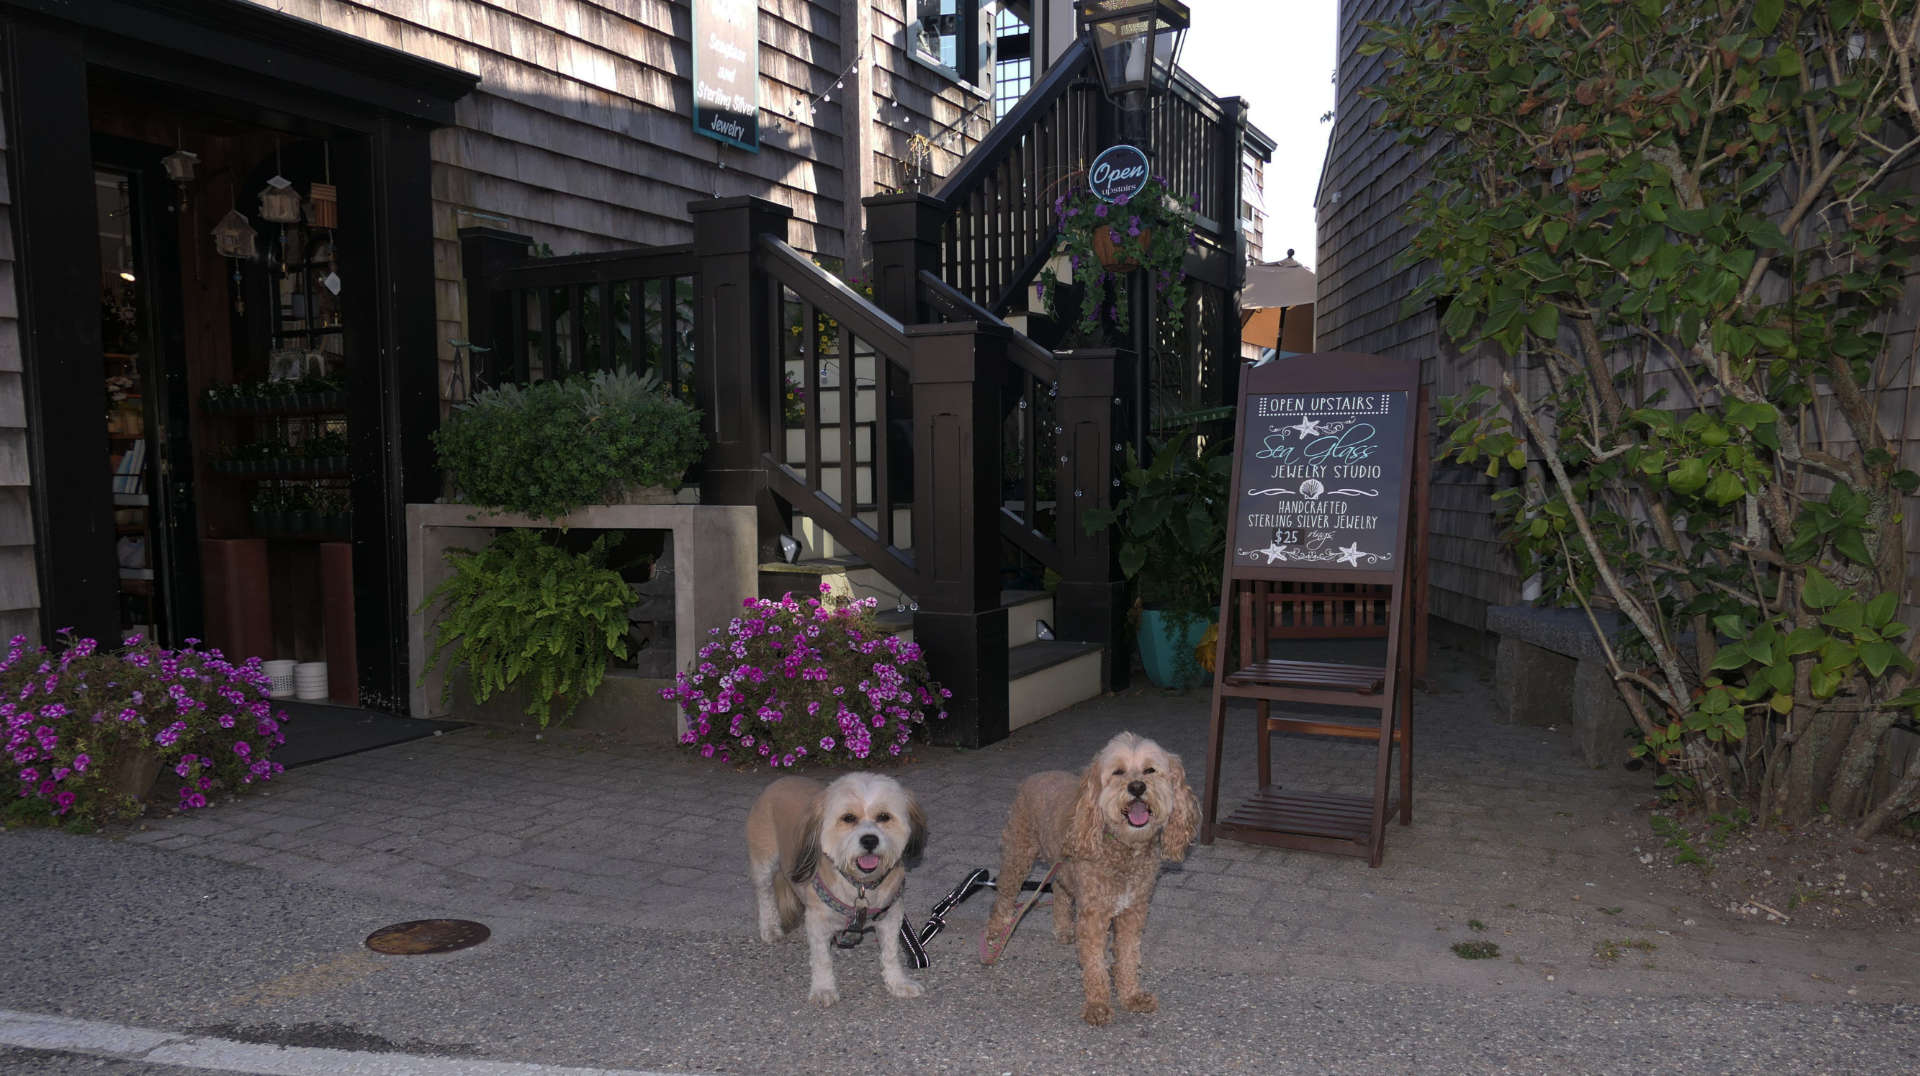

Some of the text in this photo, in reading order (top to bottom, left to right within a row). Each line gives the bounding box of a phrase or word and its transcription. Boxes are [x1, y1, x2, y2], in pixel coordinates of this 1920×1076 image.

[697, 80, 757, 116] Sterling Silver
[711, 113, 745, 141] Jewelry
[1093, 162, 1145, 192] Open
[1270, 396, 1375, 412] OPEN UPSTAIRS
[1256, 423, 1379, 467] Sea Glass
[1271, 465, 1381, 479] JEWELRY STUDIO
[1278, 500, 1348, 515] HANDCRAFTED
[1248, 513, 1379, 530] STERLING SILVER JEWELRY
[1274, 528, 1299, 544] $25
